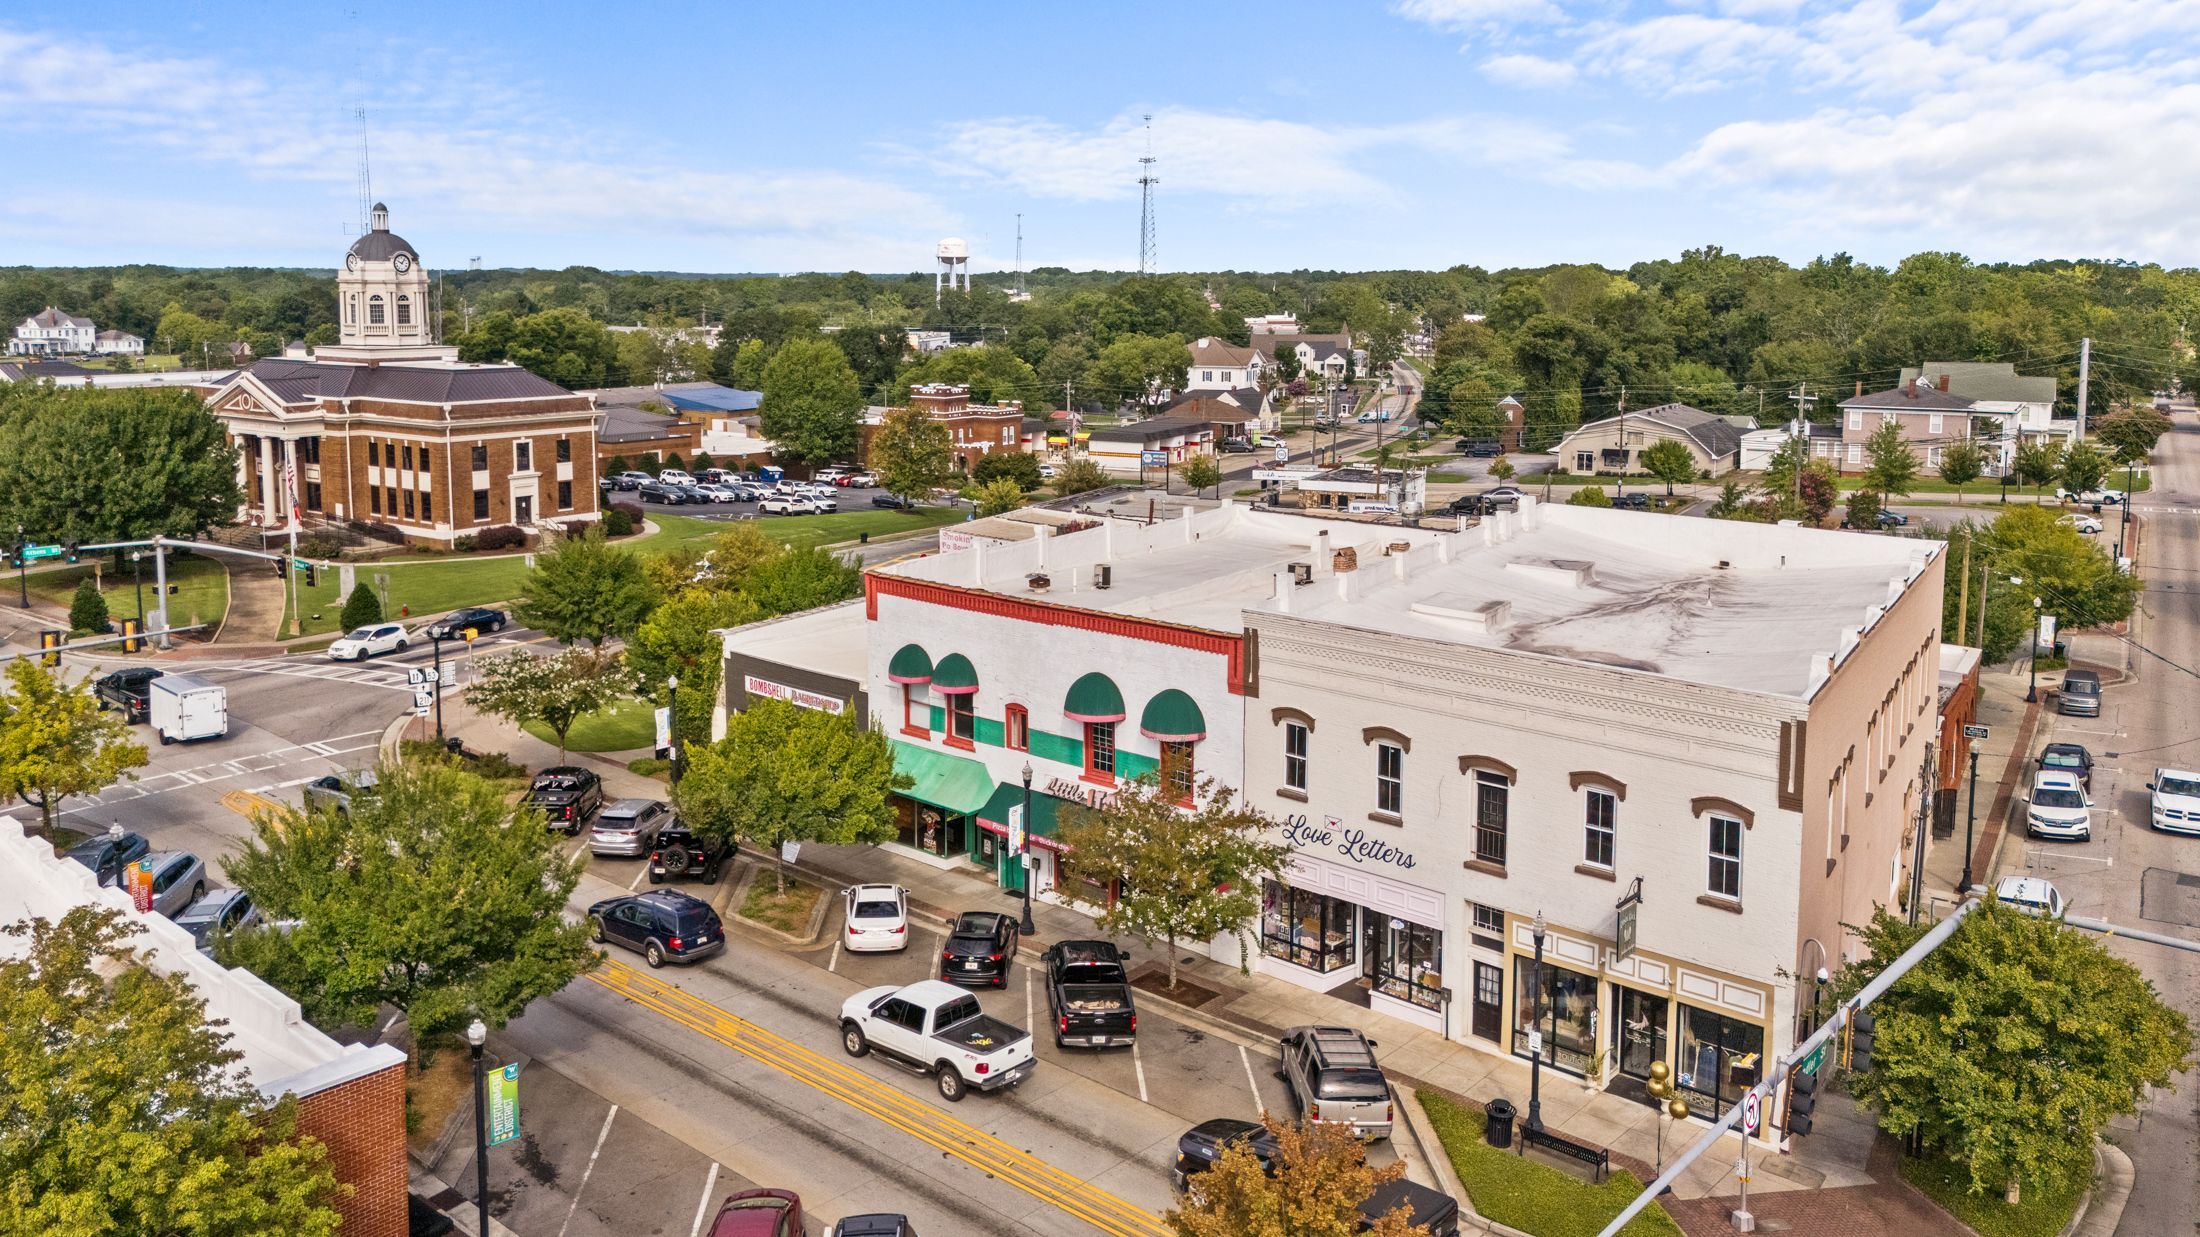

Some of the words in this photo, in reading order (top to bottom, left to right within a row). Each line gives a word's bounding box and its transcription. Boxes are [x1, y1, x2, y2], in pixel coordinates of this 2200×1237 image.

[419, 696, 430, 706] 211
[749, 678, 786, 698] BOMBSHELL
[1043, 777, 1085, 801] Little
[992, 822, 1006, 832] Pizza
[1282, 814, 1333, 847] Love
[1338, 829, 1417, 869] Letters
[140, 884, 149, 911] DISTRICT
[491, 1073, 504, 1137] ENTERTAINMENT
[503, 1098, 514, 1133] DISTRICT
